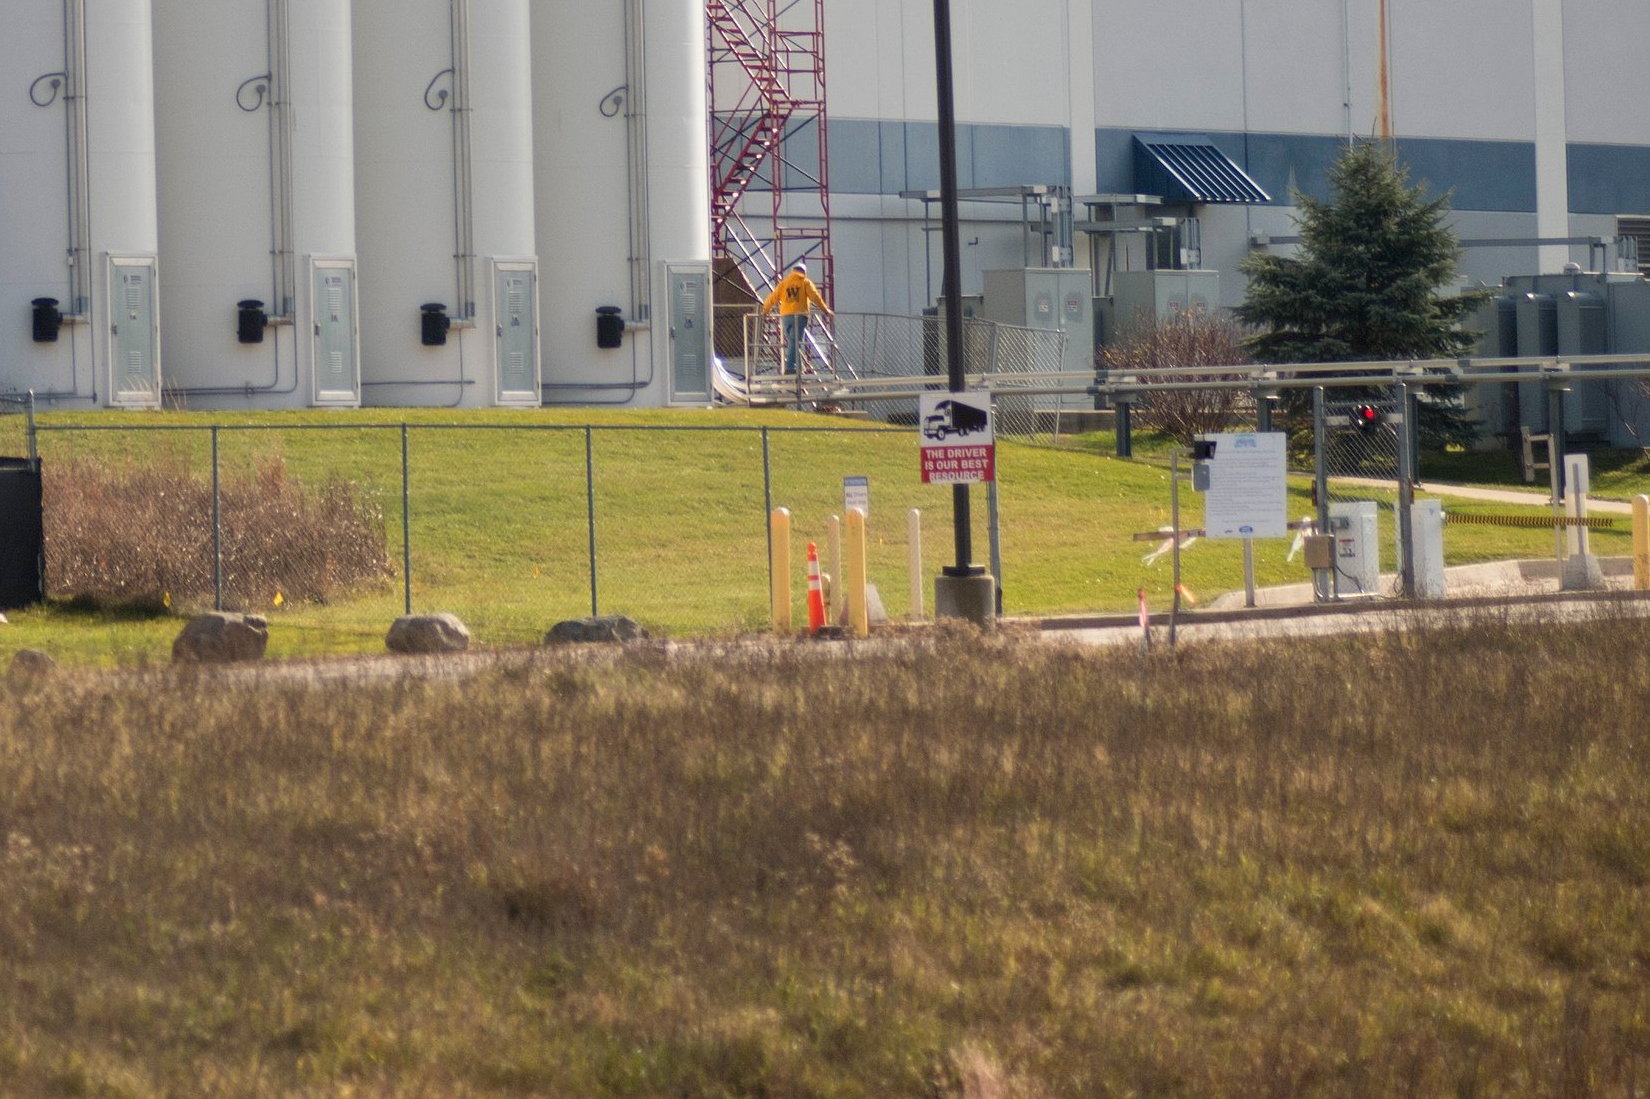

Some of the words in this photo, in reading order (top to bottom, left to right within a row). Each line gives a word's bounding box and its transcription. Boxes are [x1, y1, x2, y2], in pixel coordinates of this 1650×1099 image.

[926, 449, 945, 459] THE
[947, 447, 987, 458] DRIVER
[925, 461, 934, 470] IS
[936, 460, 958, 470] OUR
[961, 459, 989, 469] BEST
[929, 470, 985, 482] RESOURCE
